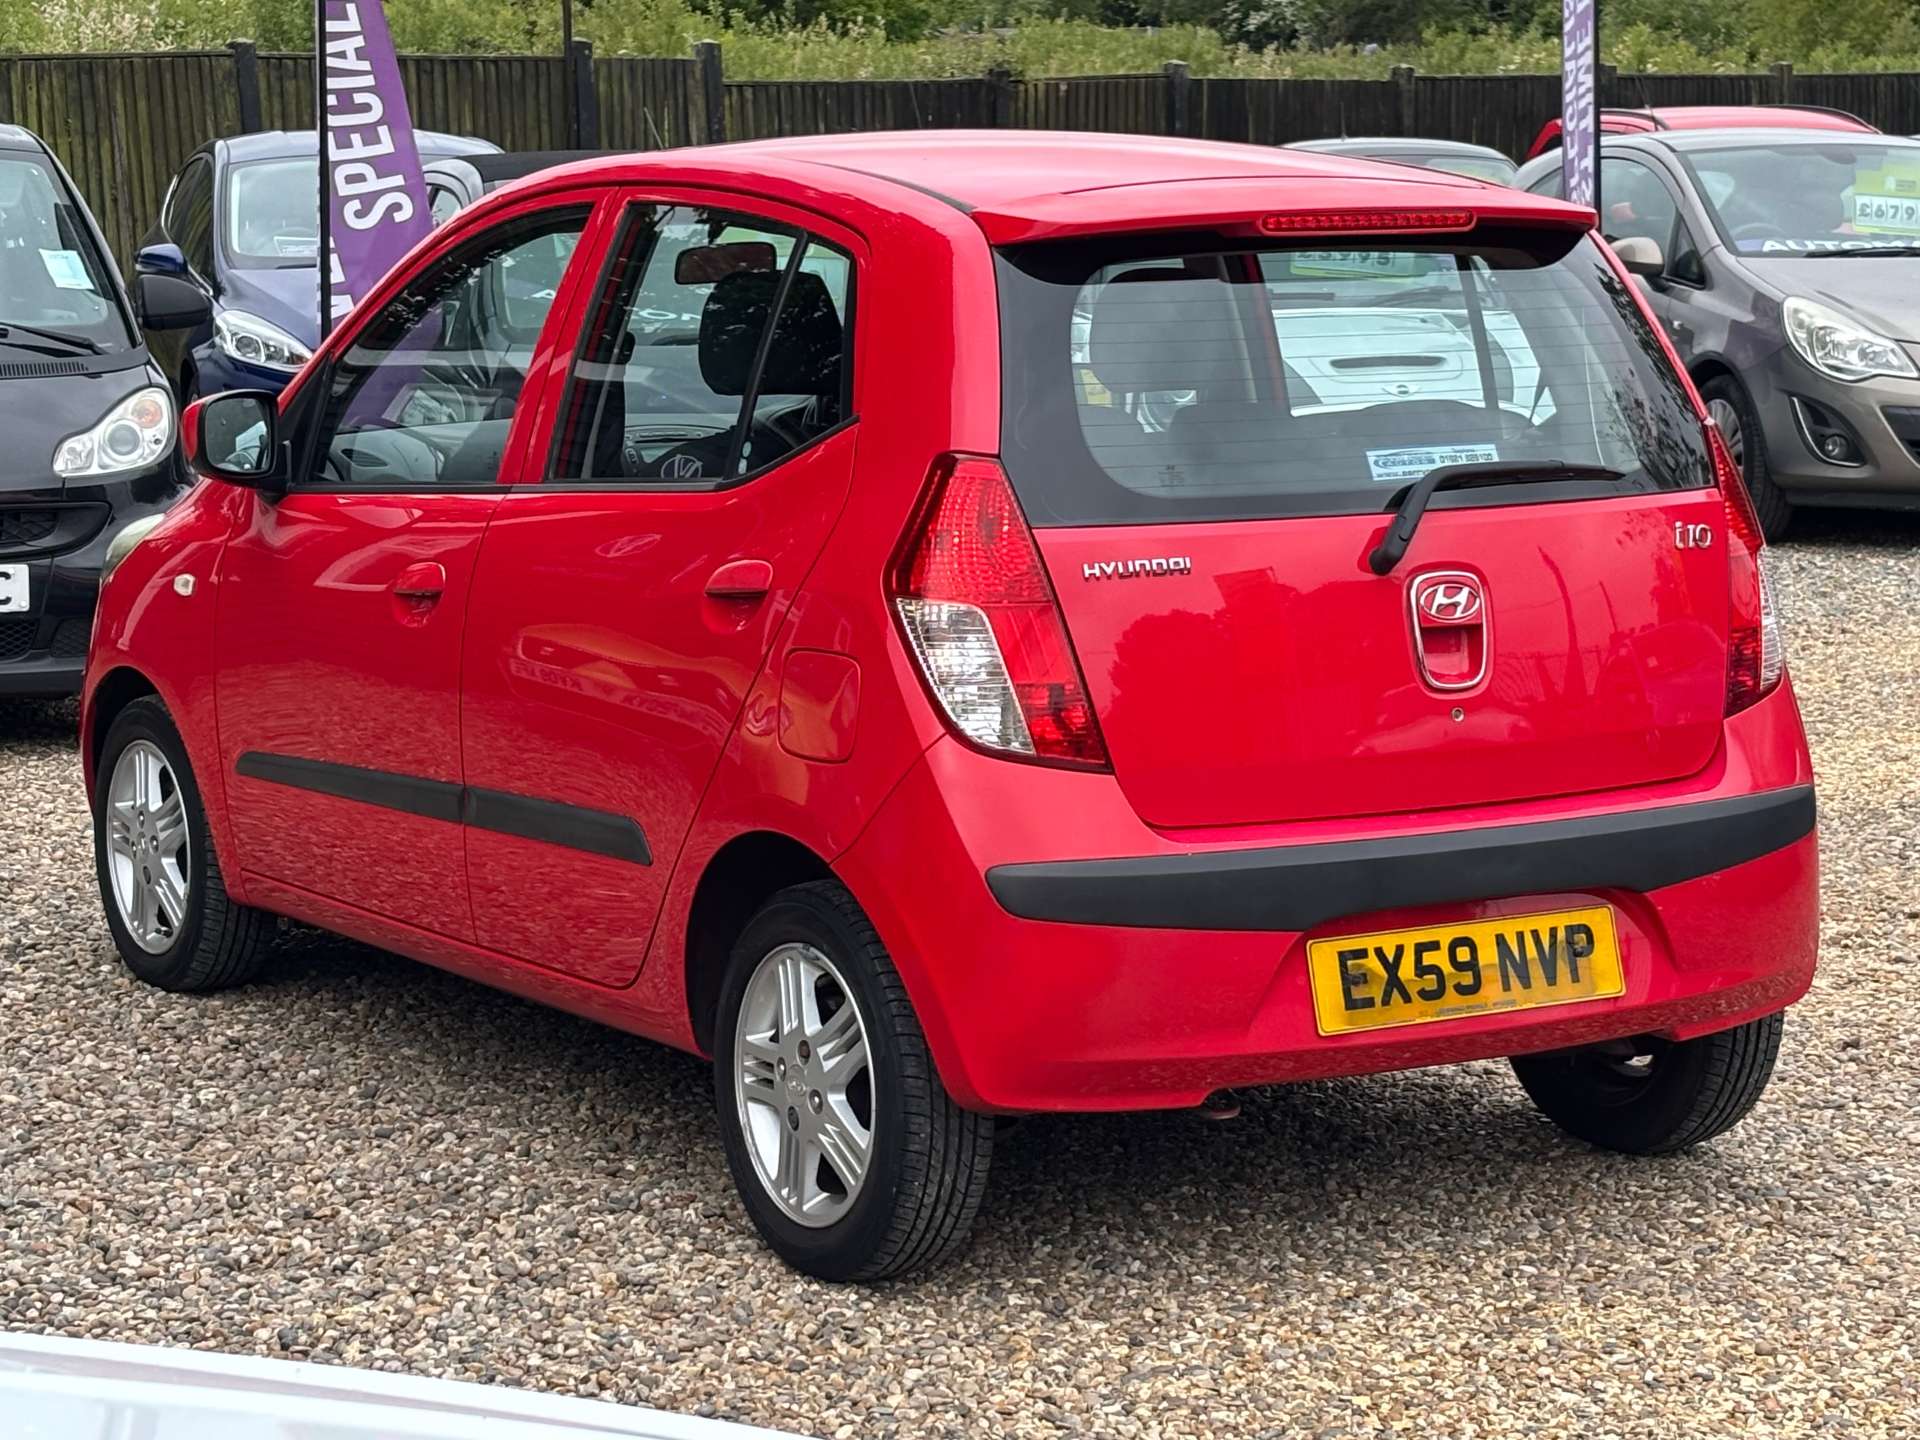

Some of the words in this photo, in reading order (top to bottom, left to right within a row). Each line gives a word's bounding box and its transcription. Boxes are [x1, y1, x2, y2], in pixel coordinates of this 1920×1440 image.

[1675, 521, 1711, 549] i10
[1083, 557, 1191, 580] HYUNDAI
[1337, 937, 1482, 1011] EX59
[1495, 923, 1594, 993] NVP
